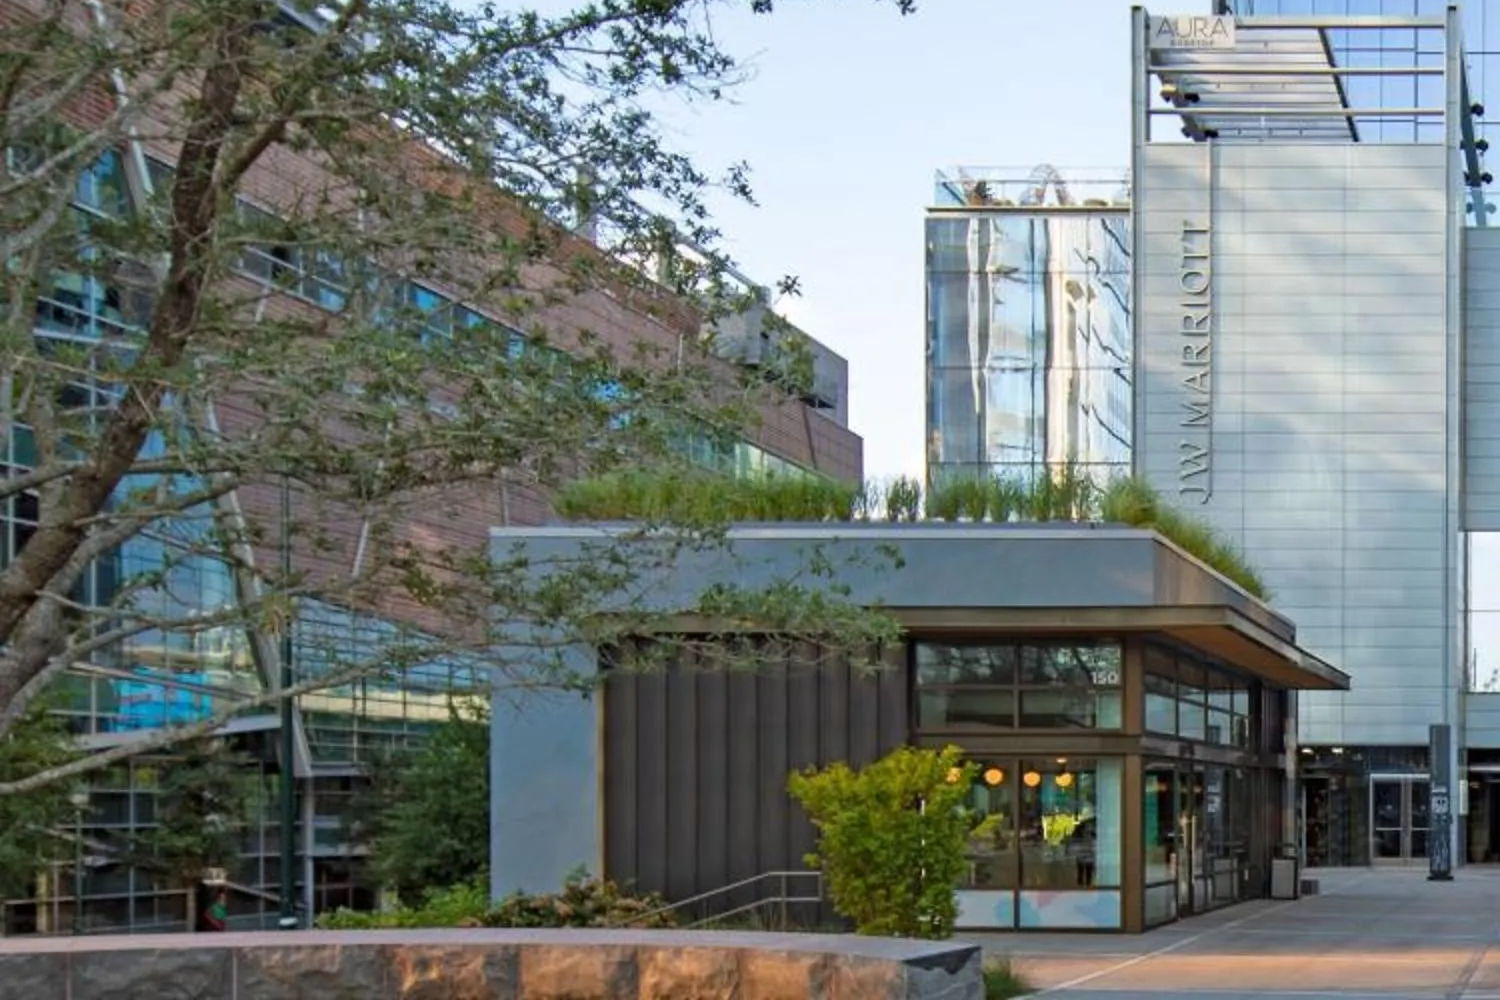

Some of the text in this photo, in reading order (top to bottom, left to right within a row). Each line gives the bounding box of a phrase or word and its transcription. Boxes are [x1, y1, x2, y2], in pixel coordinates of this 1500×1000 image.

[1156, 16, 1229, 38] AURA
[1179, 219, 1212, 505] JW MARRIOTT
